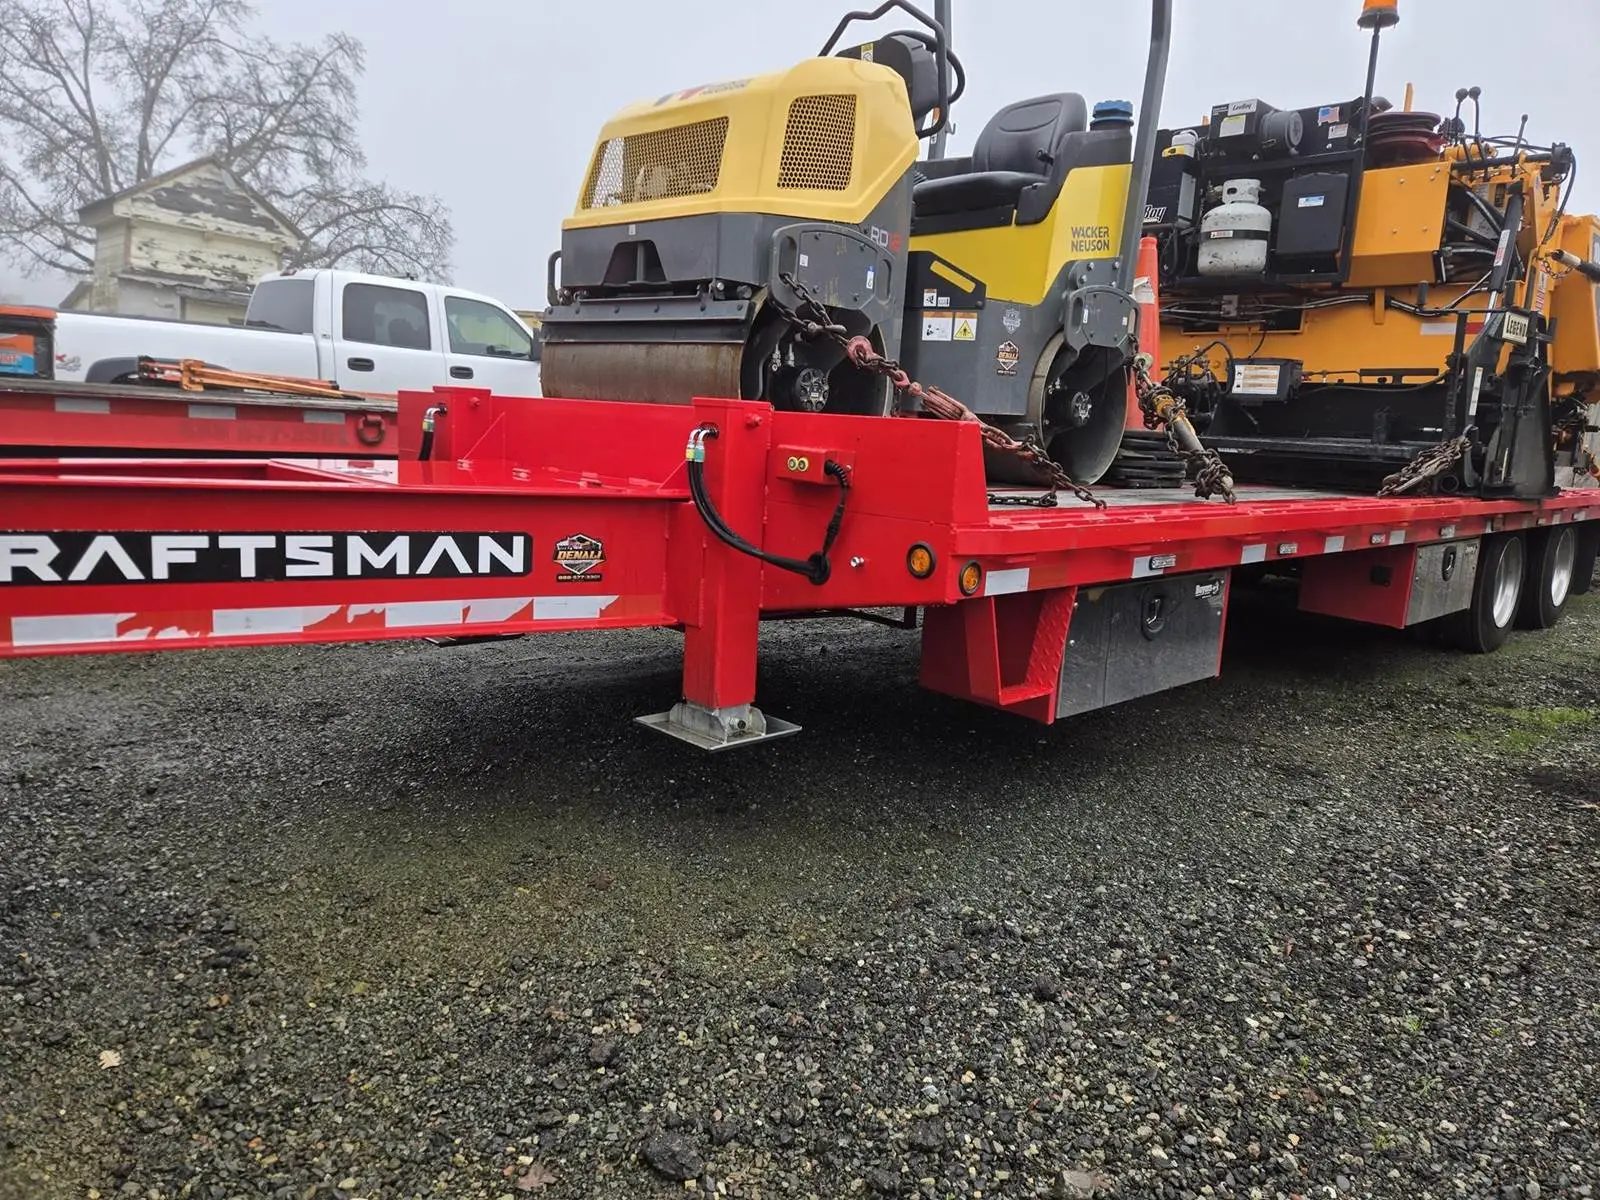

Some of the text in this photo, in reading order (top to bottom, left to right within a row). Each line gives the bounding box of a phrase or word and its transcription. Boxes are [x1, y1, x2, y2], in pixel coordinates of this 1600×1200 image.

[1071, 226, 1110, 239] WACKER
[1071, 239, 1110, 252] NEUSON
[557, 550, 602, 560] DENALI
